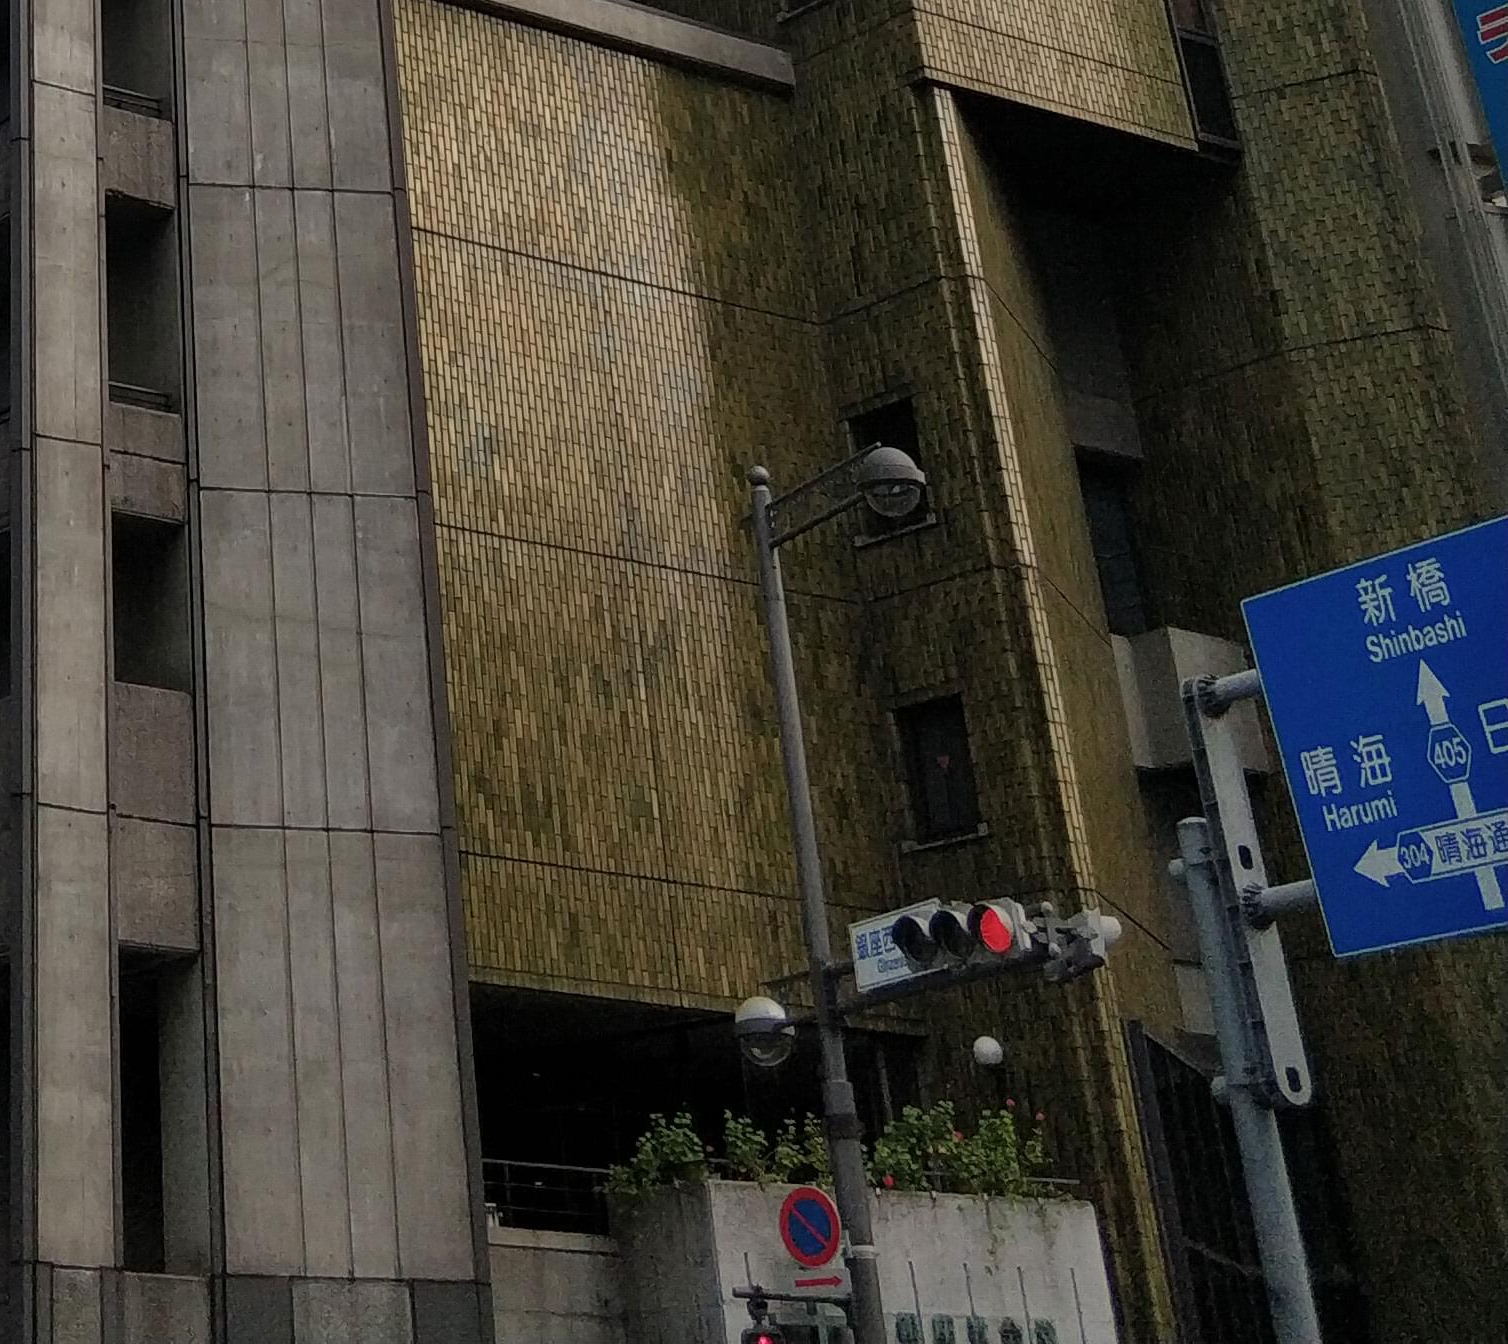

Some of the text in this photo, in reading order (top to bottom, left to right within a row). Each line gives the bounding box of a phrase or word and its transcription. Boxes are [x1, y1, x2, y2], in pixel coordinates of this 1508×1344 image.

[1356, 558, 1450, 626] 新橋
[1364, 611, 1468, 664] Shinbashi
[1299, 733, 1393, 799] 晴海
[1433, 736, 1468, 770] 405
[1321, 790, 1399, 833] Harumi
[1400, 842, 1430, 870] 304
